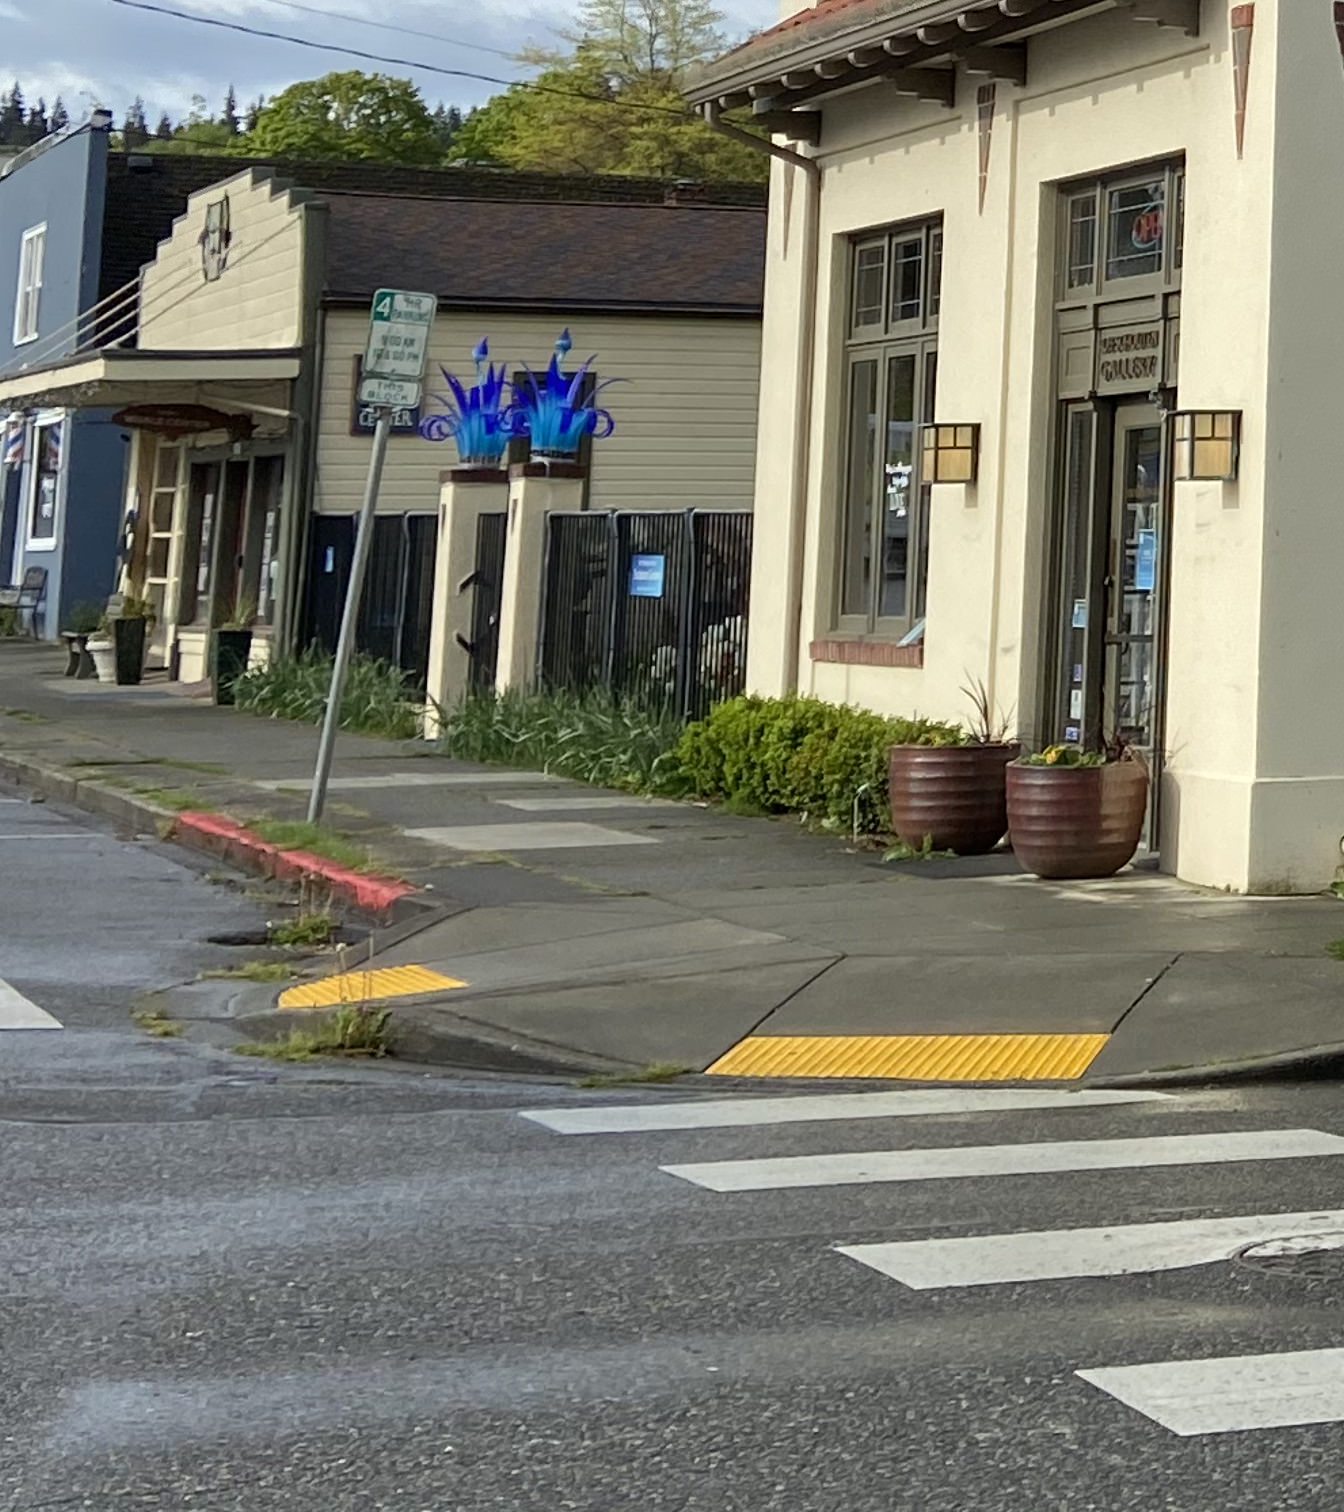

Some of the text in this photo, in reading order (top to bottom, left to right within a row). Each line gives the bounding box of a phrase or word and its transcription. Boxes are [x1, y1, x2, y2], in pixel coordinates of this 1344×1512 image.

[1134, 209, 1163, 243] OPE
[376, 296, 391, 317] 4
[1101, 355, 1158, 383] GALLERY
[367, 390, 409, 402] BLOCK
[377, 381, 404, 393] THIS
[359, 409, 413, 426] CETER
